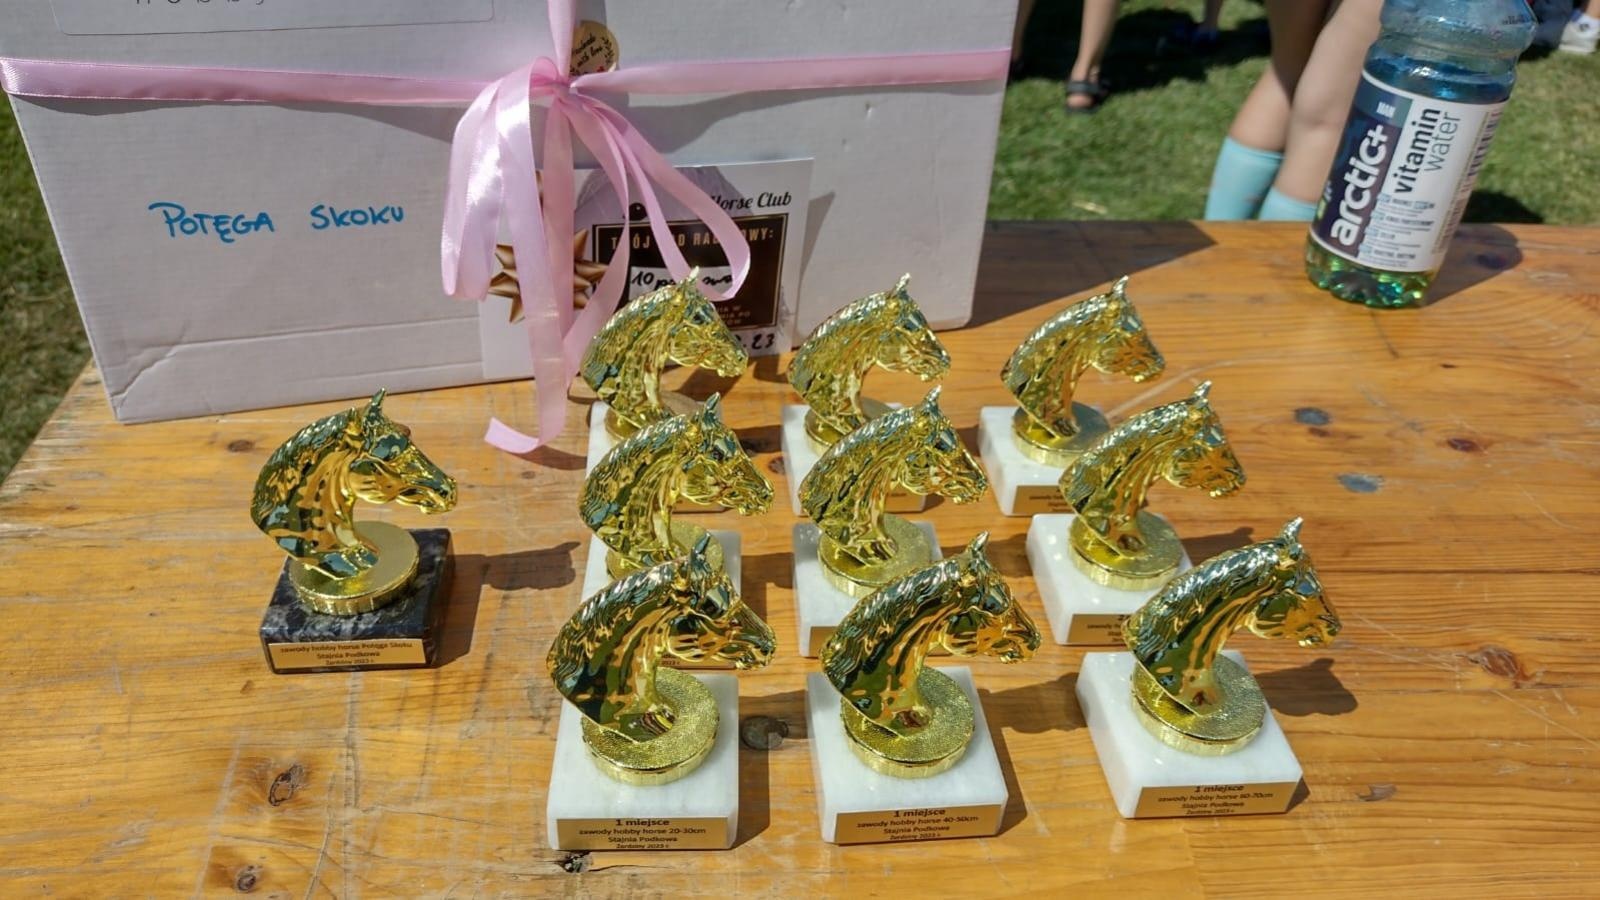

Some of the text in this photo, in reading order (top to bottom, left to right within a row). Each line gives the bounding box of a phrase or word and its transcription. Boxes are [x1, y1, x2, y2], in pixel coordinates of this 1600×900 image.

[1424, 111, 1461, 172] water
[1393, 108, 1441, 194] vitamin
[1330, 124, 1388, 246] arctic+
[757, 191, 792, 208] Club
[611, 235, 651, 250] TÓJ
[693, 228, 774, 247] RABOWY:
[631, 271, 654, 286] 10
[1194, 784, 1245, 793] 1 miejsce
[893, 808, 946, 818] 1 miejsce
[625, 818, 670, 827] miejsce
[613, 828, 640, 836] hobby
